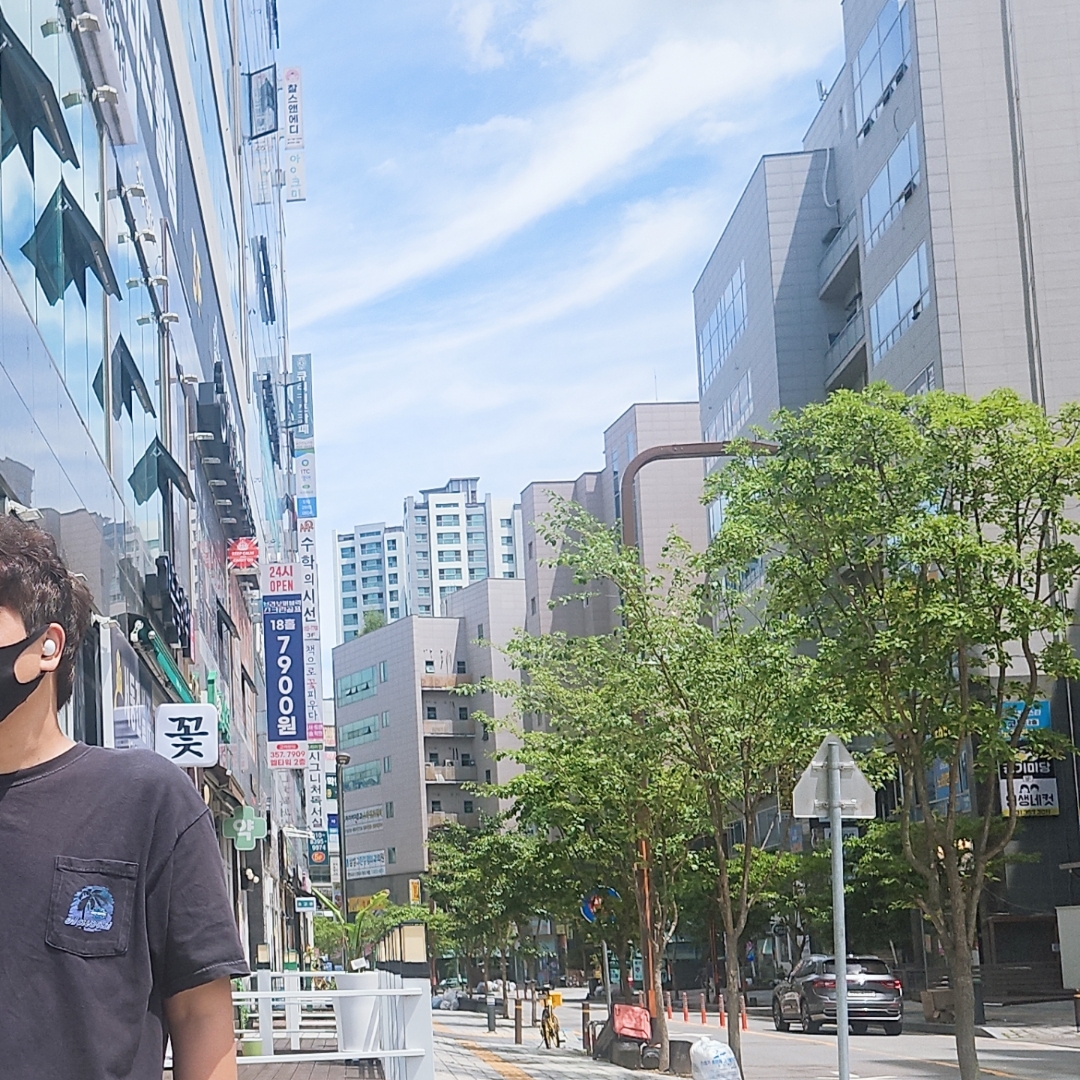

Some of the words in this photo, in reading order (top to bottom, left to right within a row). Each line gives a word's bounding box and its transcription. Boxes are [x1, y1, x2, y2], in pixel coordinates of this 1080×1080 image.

[269, 564, 294, 578] 24시
[269, 579, 294, 592] OPEN
[300, 536, 317, 623] 수학의시선
[270, 618, 296, 631] 18홀
[276, 635, 297, 736] 7900원
[164, 716, 210, 761] 꽃
[308, 750, 323, 829] 시그니처독서실
[232, 818, 255, 841] 약
